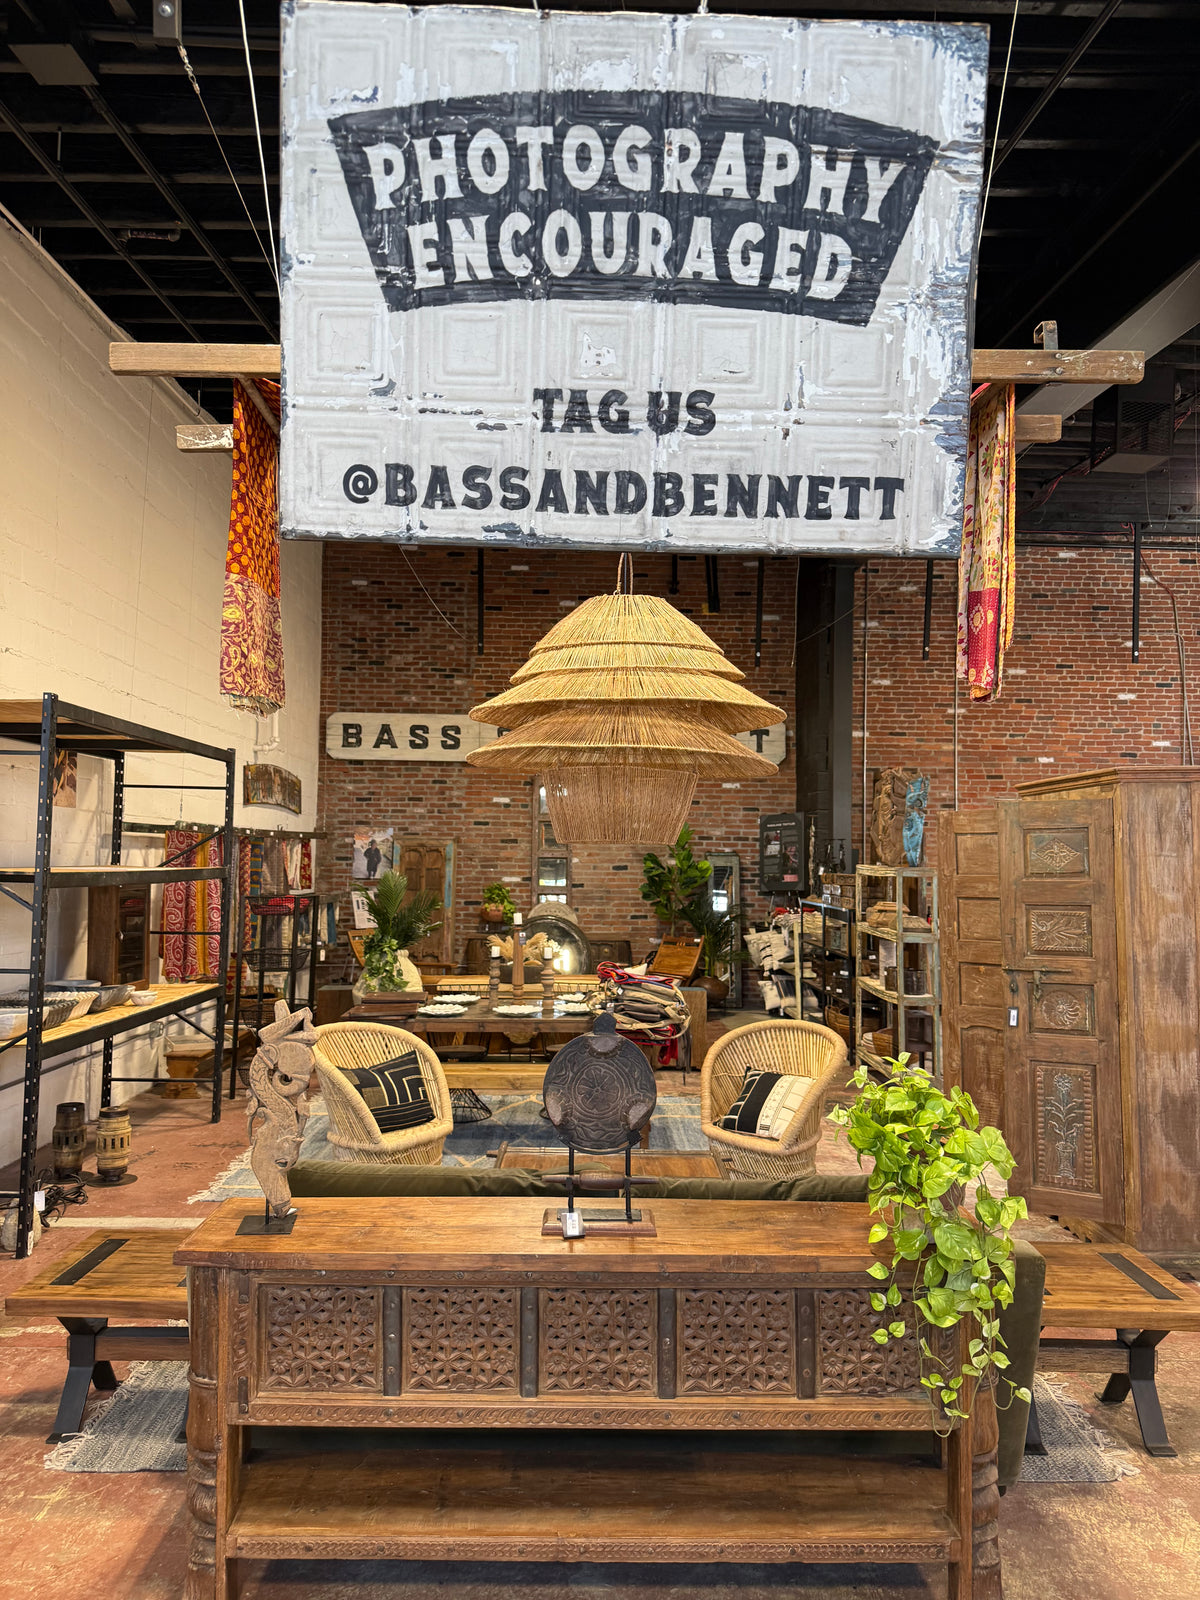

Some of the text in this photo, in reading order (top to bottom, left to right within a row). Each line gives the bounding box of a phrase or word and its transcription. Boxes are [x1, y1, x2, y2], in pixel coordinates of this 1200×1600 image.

[362, 124, 907, 224] PHOTOGRAPHY
[407, 209, 852, 299] ENCOURAGED
[533, 388, 717, 436] TAG US
[342, 463, 905, 521] @BASSANDBENNETT
[342, 723, 462, 750] BASS
